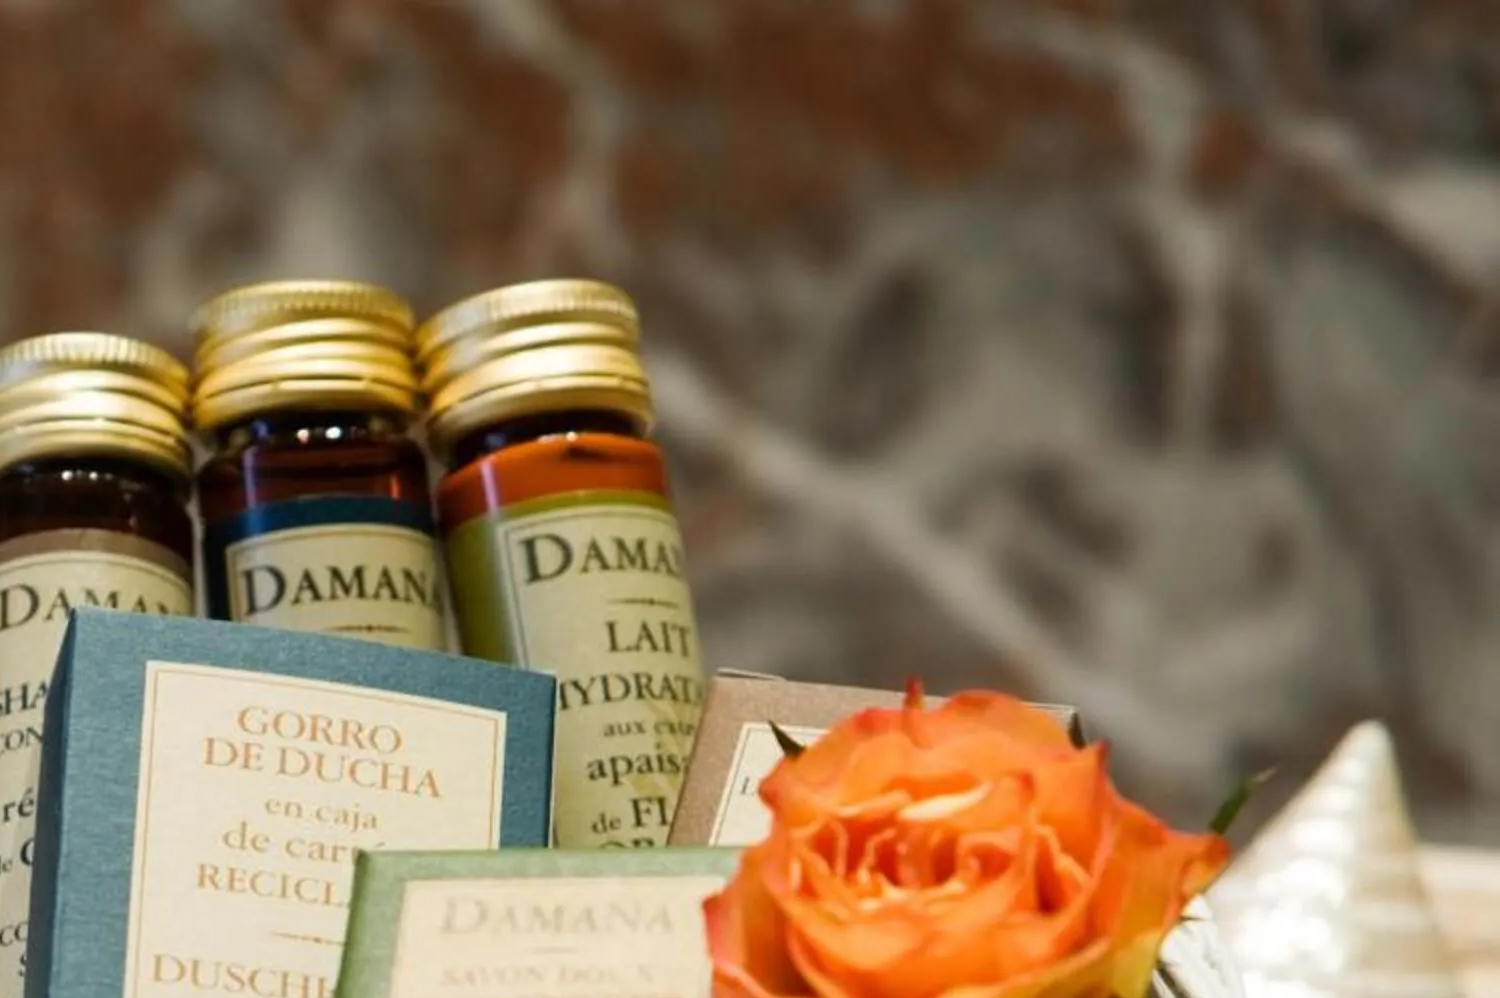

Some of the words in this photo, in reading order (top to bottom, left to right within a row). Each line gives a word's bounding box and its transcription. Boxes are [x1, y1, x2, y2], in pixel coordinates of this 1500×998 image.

[606, 620, 691, 658] LAIT
[237, 705, 402, 754] GORRO
[603, 718, 647, 738] aux
[203, 736, 265, 772] DE
[276, 746, 441, 798] DUCHA
[264, 797, 304, 819] en
[315, 802, 378, 833] caja
[591, 809, 622, 835] de
[222, 819, 271, 853] de
[284, 838, 386, 864] car
[197, 862, 350, 908] RECICL
[440, 897, 675, 935] DAMANA
